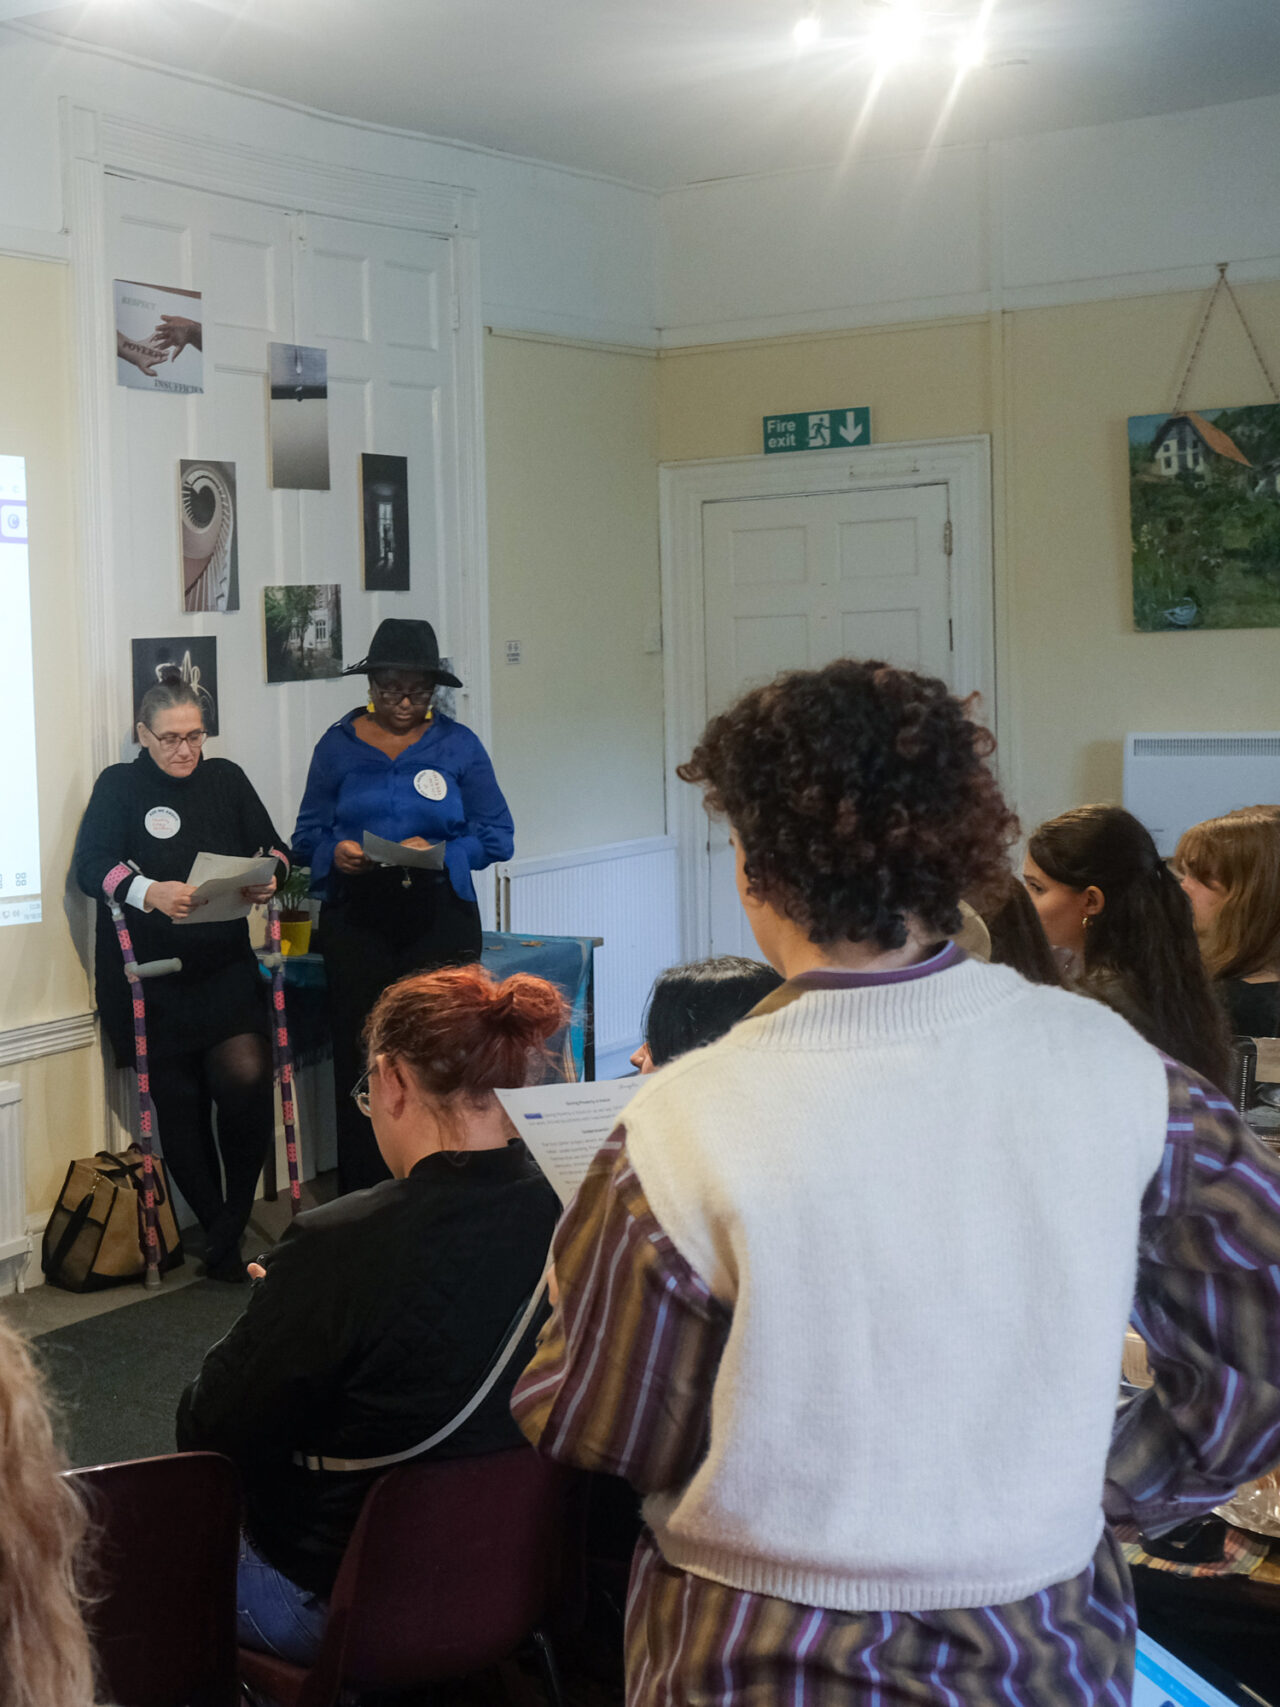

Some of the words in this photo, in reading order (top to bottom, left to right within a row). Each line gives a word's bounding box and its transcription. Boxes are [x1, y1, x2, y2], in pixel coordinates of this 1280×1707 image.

[121, 296, 156, 311] RESPECT
[767, 420, 796, 434] Fire
[768, 433, 797, 449] exit
